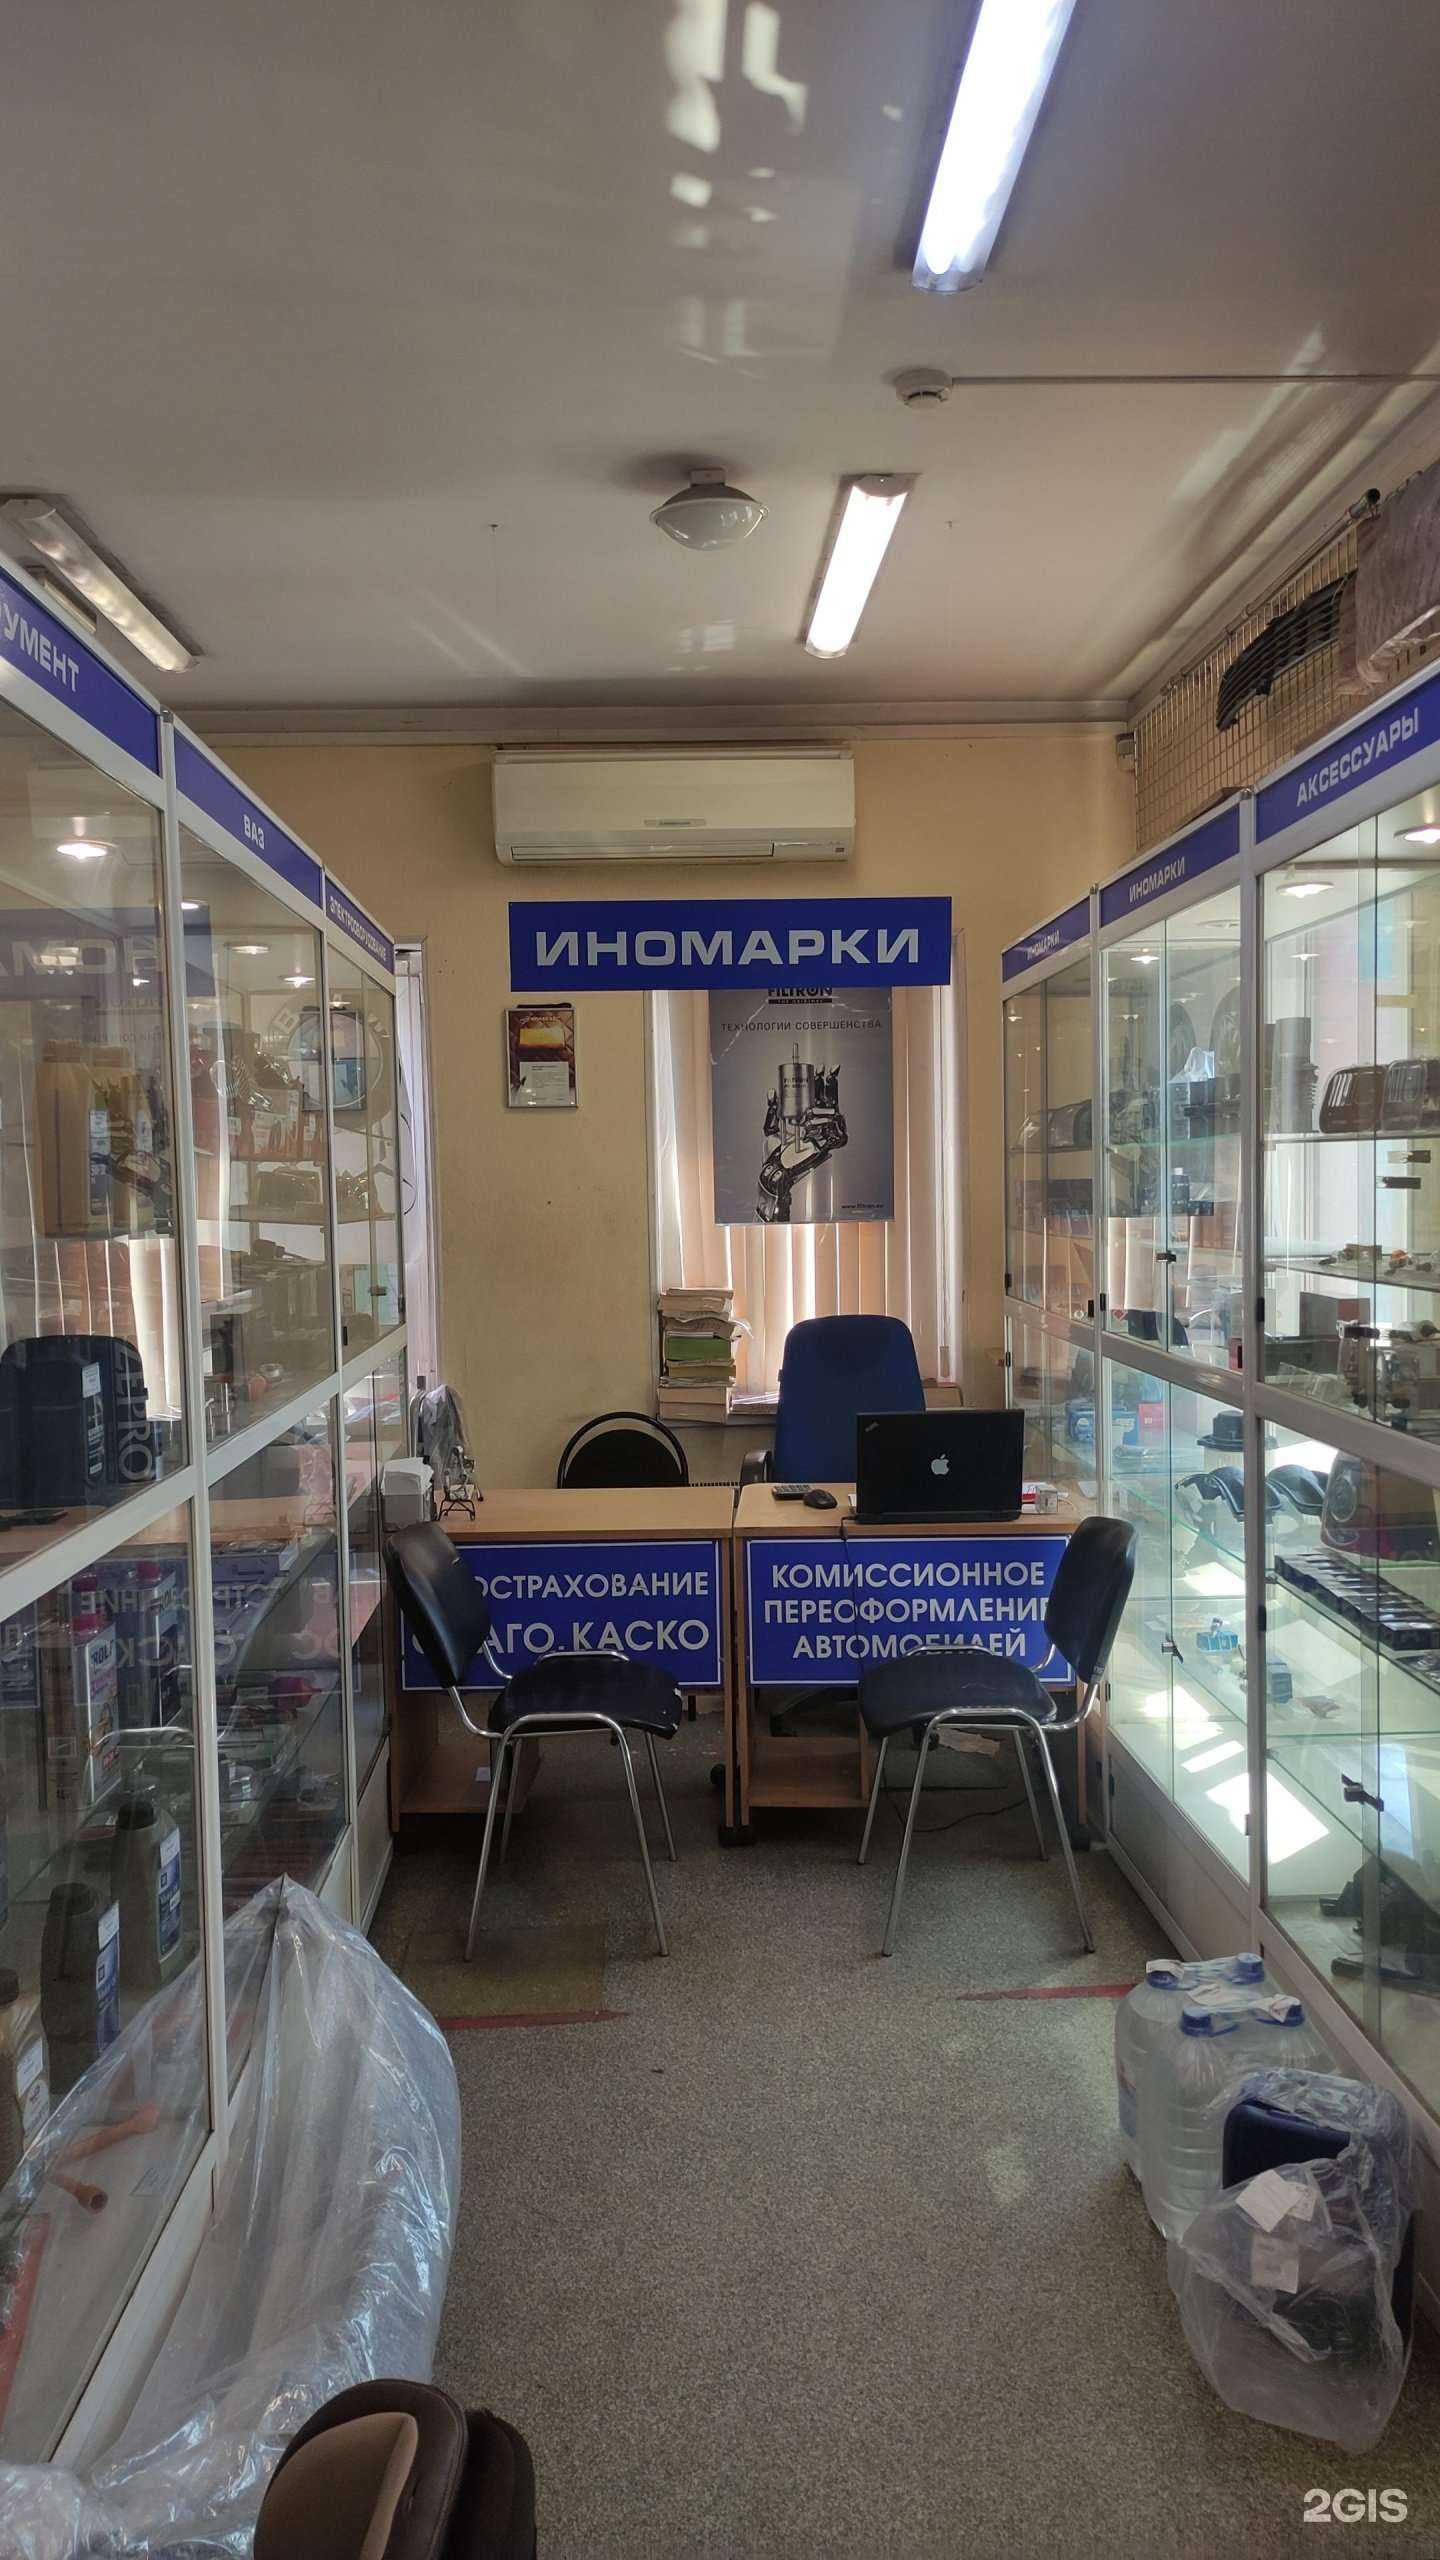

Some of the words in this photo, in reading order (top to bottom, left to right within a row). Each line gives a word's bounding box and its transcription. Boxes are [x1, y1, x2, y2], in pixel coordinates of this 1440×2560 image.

[0, 602, 79, 692] УМЕНТ
[1296, 707, 1419, 807] АКСЕССУАРЫ
[243, 814, 265, 850] ВАЗ
[1128, 856, 1186, 903] ИНОМАРКИ
[535, 928, 919, 967] ИНОМАРКИ
[721, 1021, 791, 1032] ТЕХНОЛОГИИ
[795, 1020, 882, 1031] СОВЕРШЕНСТВА
[474, 1572, 708, 1600] СТРАХОВАНИЕ
[772, 1562, 1045, 1589] КОМИССИОННОЕ
[573, 1619, 709, 1652] КАСКО
